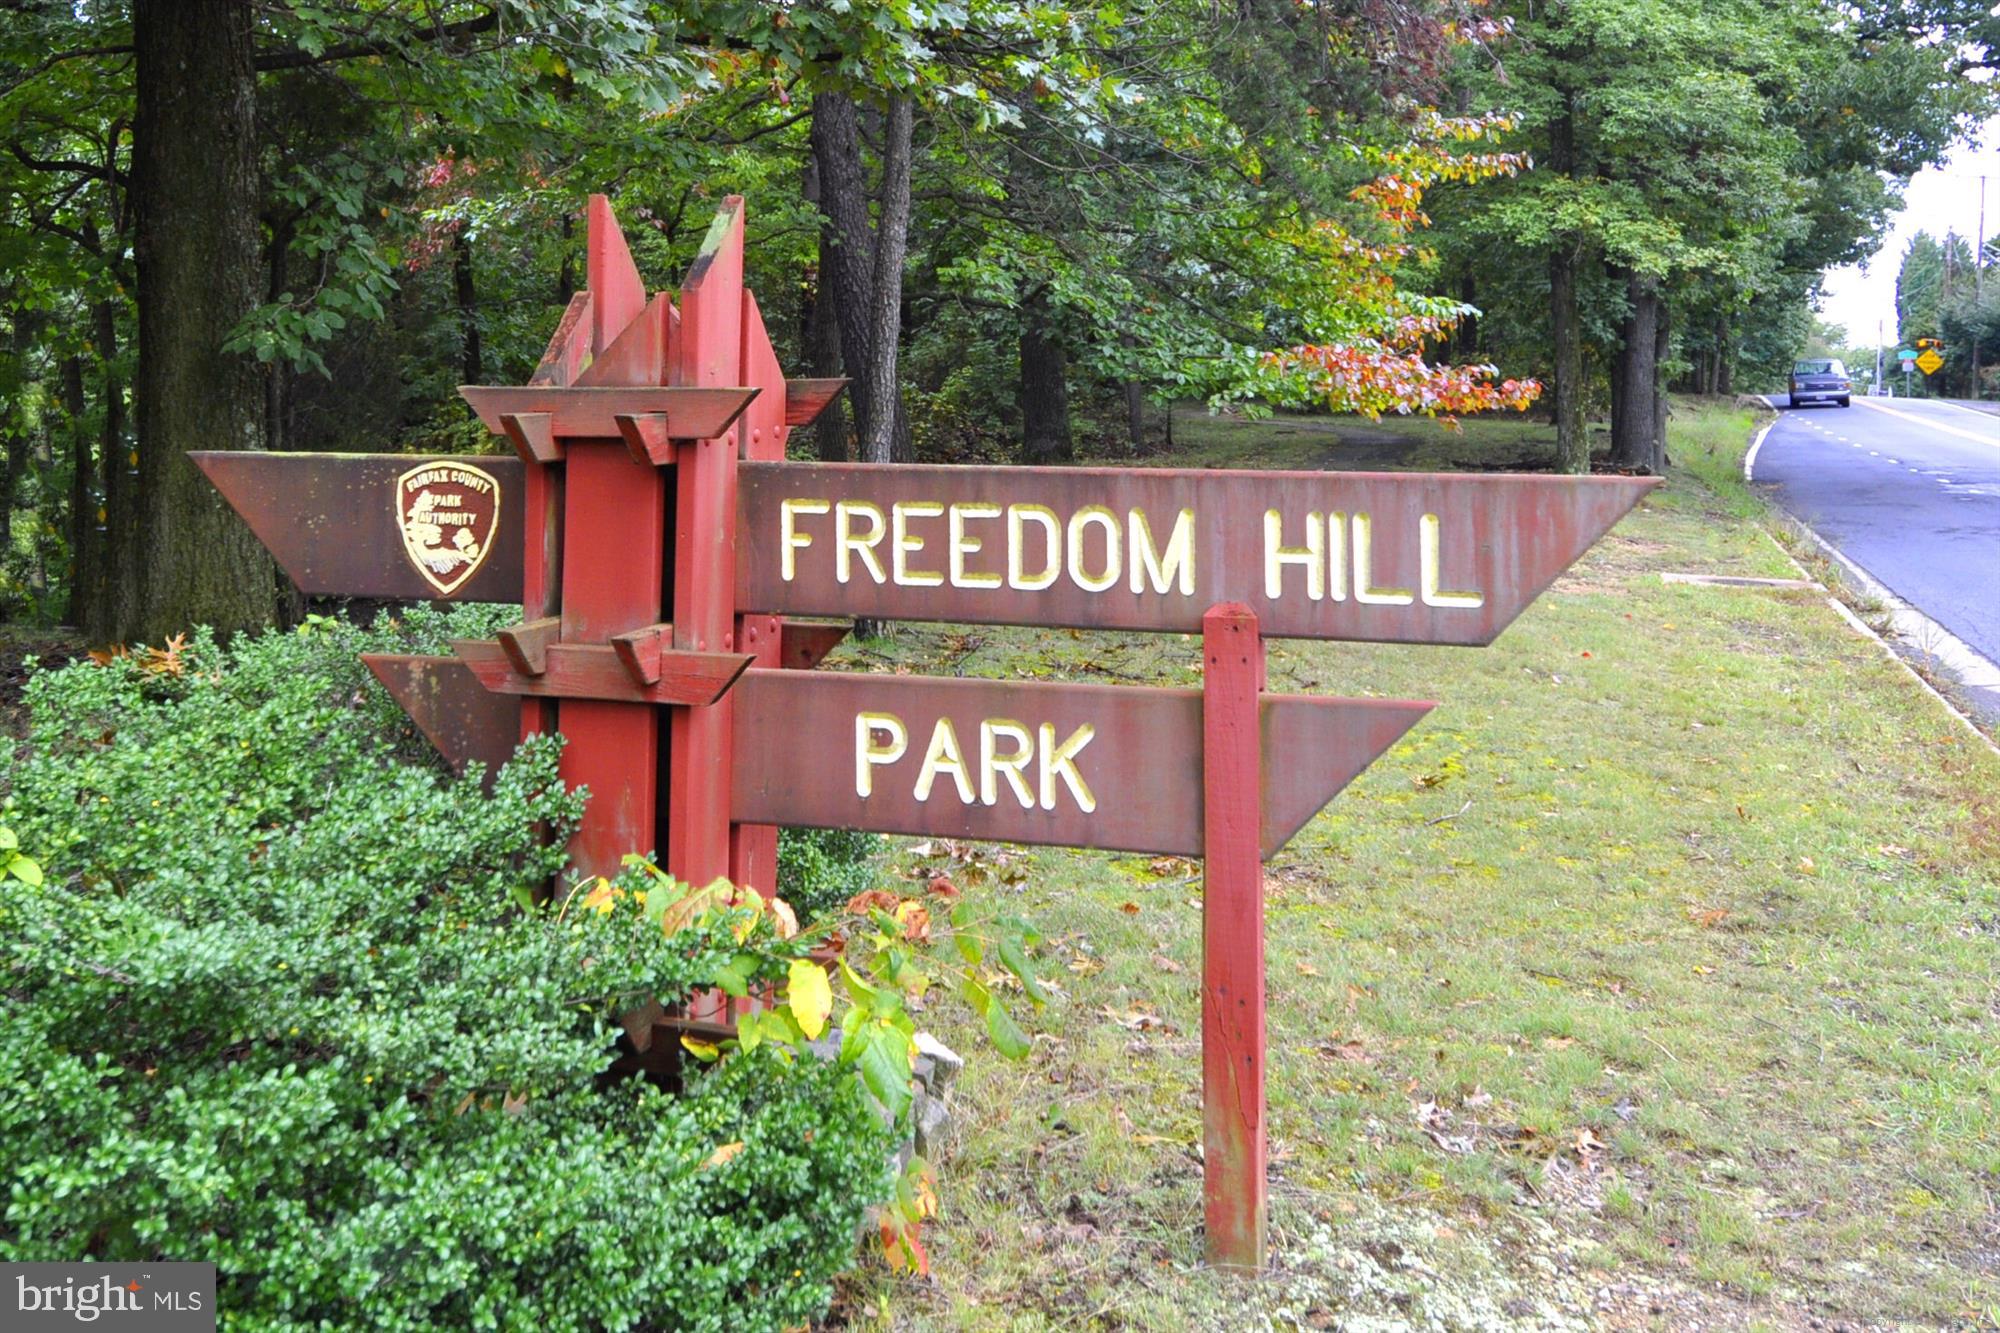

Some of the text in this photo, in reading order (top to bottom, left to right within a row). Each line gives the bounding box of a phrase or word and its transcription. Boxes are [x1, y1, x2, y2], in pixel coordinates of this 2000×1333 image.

[406, 469, 492, 494] FAIRFAX COUNTY
[435, 494, 462, 507] PARK
[418, 511, 477, 526] AUTHORITY
[781, 497, 1485, 608] FREEDOM HILL
[855, 711, 1096, 813] PARK
